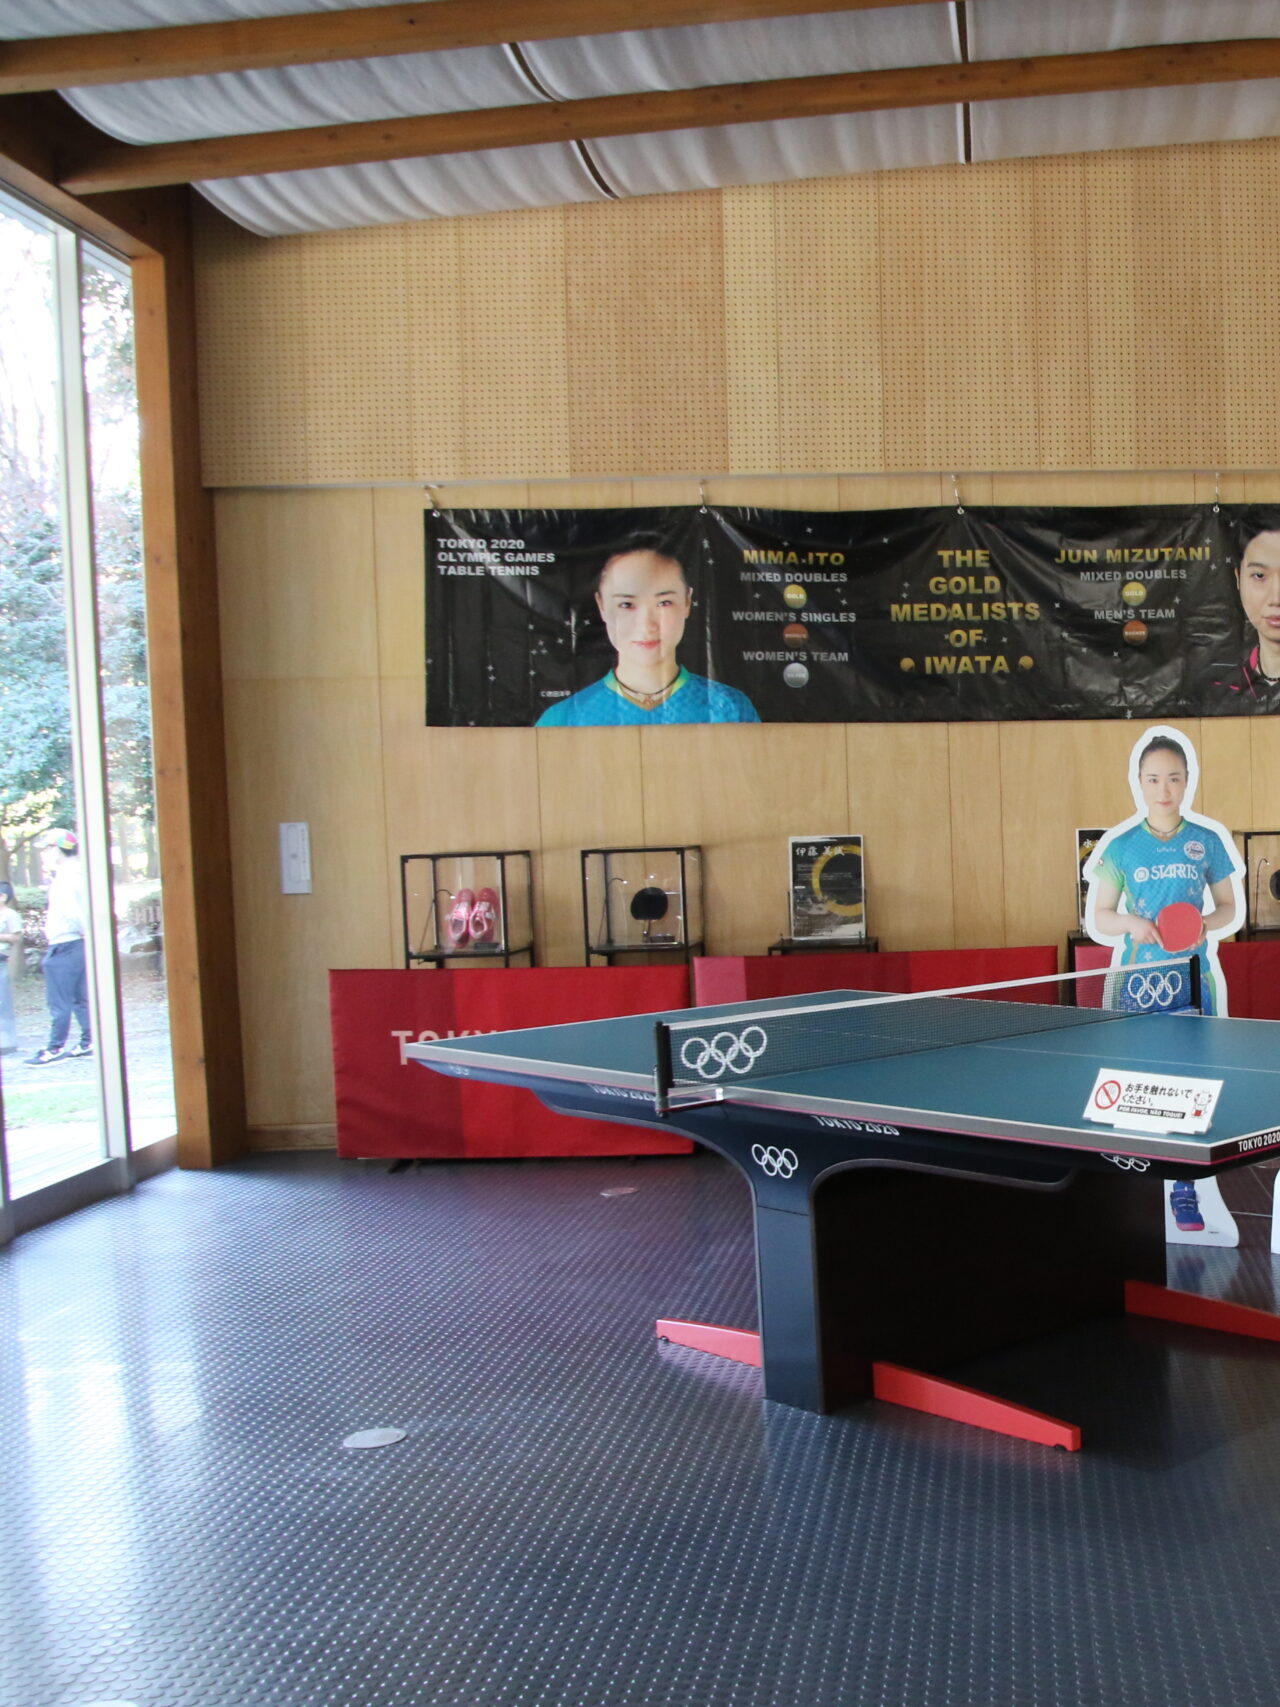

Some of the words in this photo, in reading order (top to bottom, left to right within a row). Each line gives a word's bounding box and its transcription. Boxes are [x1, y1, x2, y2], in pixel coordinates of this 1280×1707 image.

[437, 538, 487, 549] TOKYO
[490, 539, 525, 549] 2020
[437, 552, 500, 563] OLYMPIC
[504, 552, 556, 563] GAMES
[743, 549, 799, 565] MIMA
[808, 552, 845, 566] ITO
[937, 549, 991, 569] THE
[1054, 549, 1098, 564] JUN
[1106, 546, 1211, 563] MIZUTANI
[437, 565, 485, 576] TABLE
[489, 565, 540, 576] TENNIS
[740, 571, 781, 583] MIXED
[785, 572, 848, 583] DOUBLES
[1080, 571, 1122, 582] MIXED
[1125, 569, 1187, 581] DOUBLES
[928, 575, 1001, 595] GOLD
[732, 611, 797, 622] WOMEN'S
[800, 612, 857, 623] SINGLES
[890, 602, 1041, 623] MEDALISTS
[1094, 609, 1135, 620] MEN'S
[1139, 608, 1176, 619] TEAM
[949, 629, 984, 648] OF
[743, 651, 807, 661] WOMEN'S
[811, 651, 849, 662] TEAM
[924, 655, 1011, 675] IWATA
[1124, 1083, 1193, 1099] お手を触れないで
[811, 1115, 862, 1131] TOKYO
[860, 1121, 900, 1136] 2020
[1238, 1136, 1263, 1152] TOKYO
[1263, 1131, 1280, 1146] 2020
